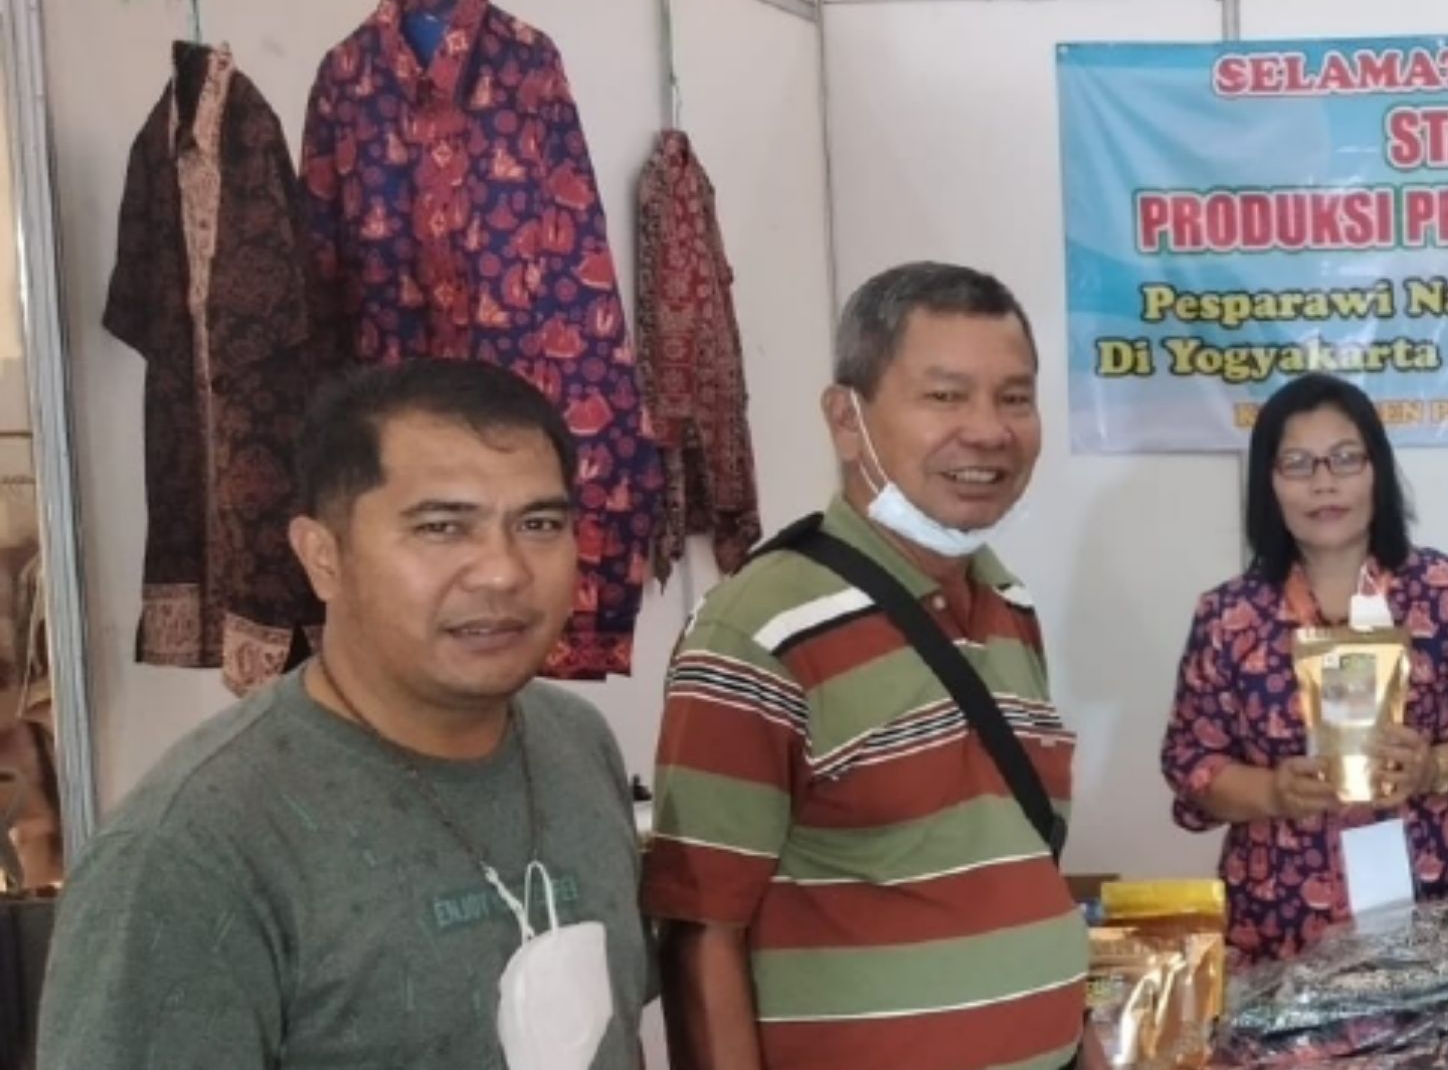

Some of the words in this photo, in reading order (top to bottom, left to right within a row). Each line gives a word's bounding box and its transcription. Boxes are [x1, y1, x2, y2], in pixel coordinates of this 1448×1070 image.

[1138, 189, 1395, 250] PRODUKSI
[1141, 281, 1394, 327] Pesparawi
[1097, 340, 1151, 375] Di
[1163, 334, 1440, 383] Yogyakarta
